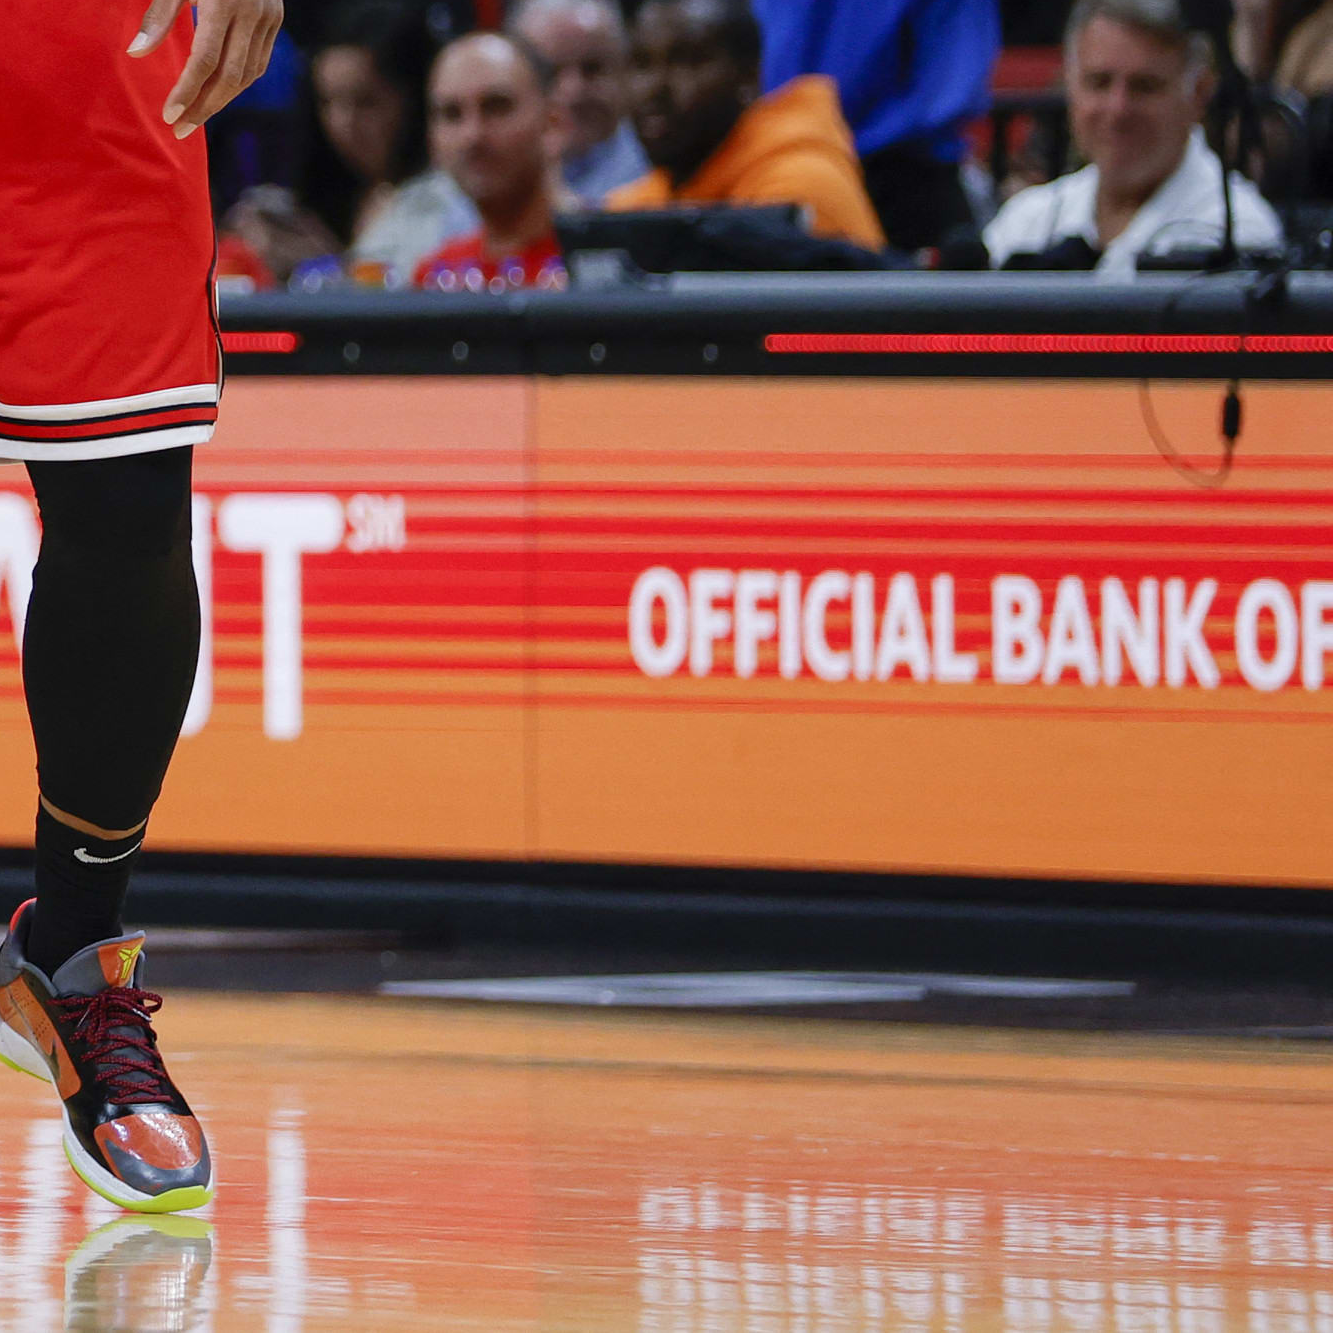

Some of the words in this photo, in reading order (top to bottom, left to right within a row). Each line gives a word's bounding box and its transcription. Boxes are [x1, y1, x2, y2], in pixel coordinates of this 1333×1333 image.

[628, 566, 979, 684] OFFICIAL
[990, 573, 1221, 690] BANK
[1234, 577, 1333, 693] OF
